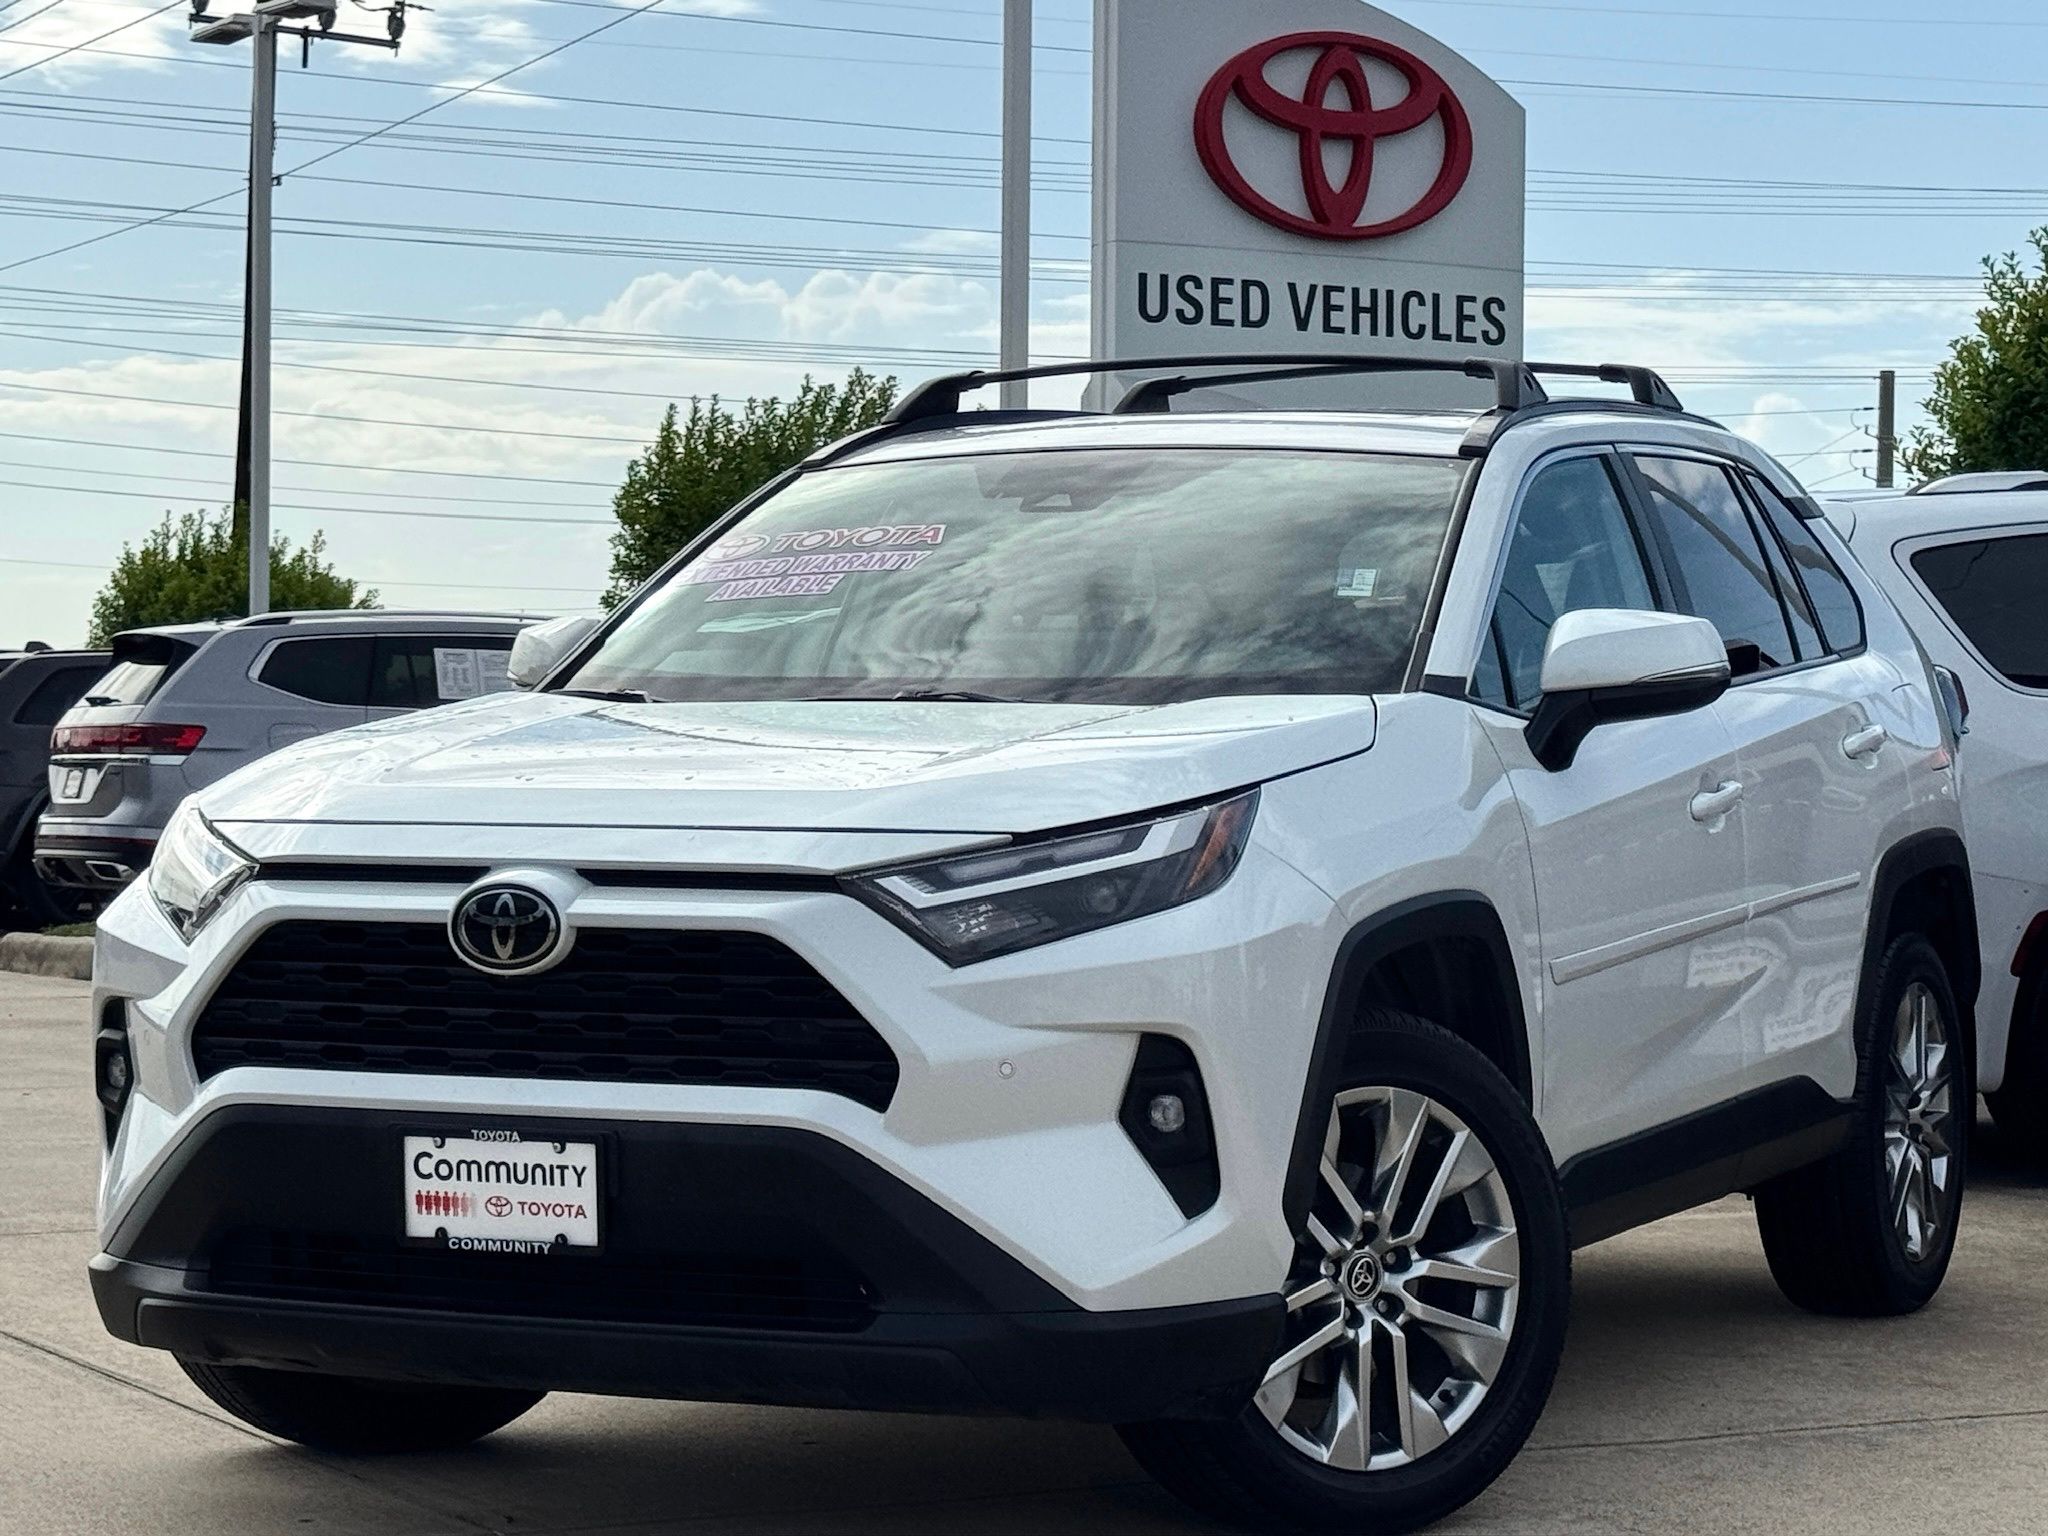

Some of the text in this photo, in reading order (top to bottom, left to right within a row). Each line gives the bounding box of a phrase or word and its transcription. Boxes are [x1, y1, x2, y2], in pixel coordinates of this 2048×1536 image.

[1138, 271, 1507, 346] USED VEHICLES
[773, 525, 945, 551] TOYOTA
[682, 552, 927, 584] XTENDED WARRANTY
[712, 574, 843, 601] AVAILABLE
[471, 1129, 521, 1142] TOYOTA
[517, 1201, 587, 1219] TOYOTA
[448, 1237, 552, 1255] COMMUNITY
